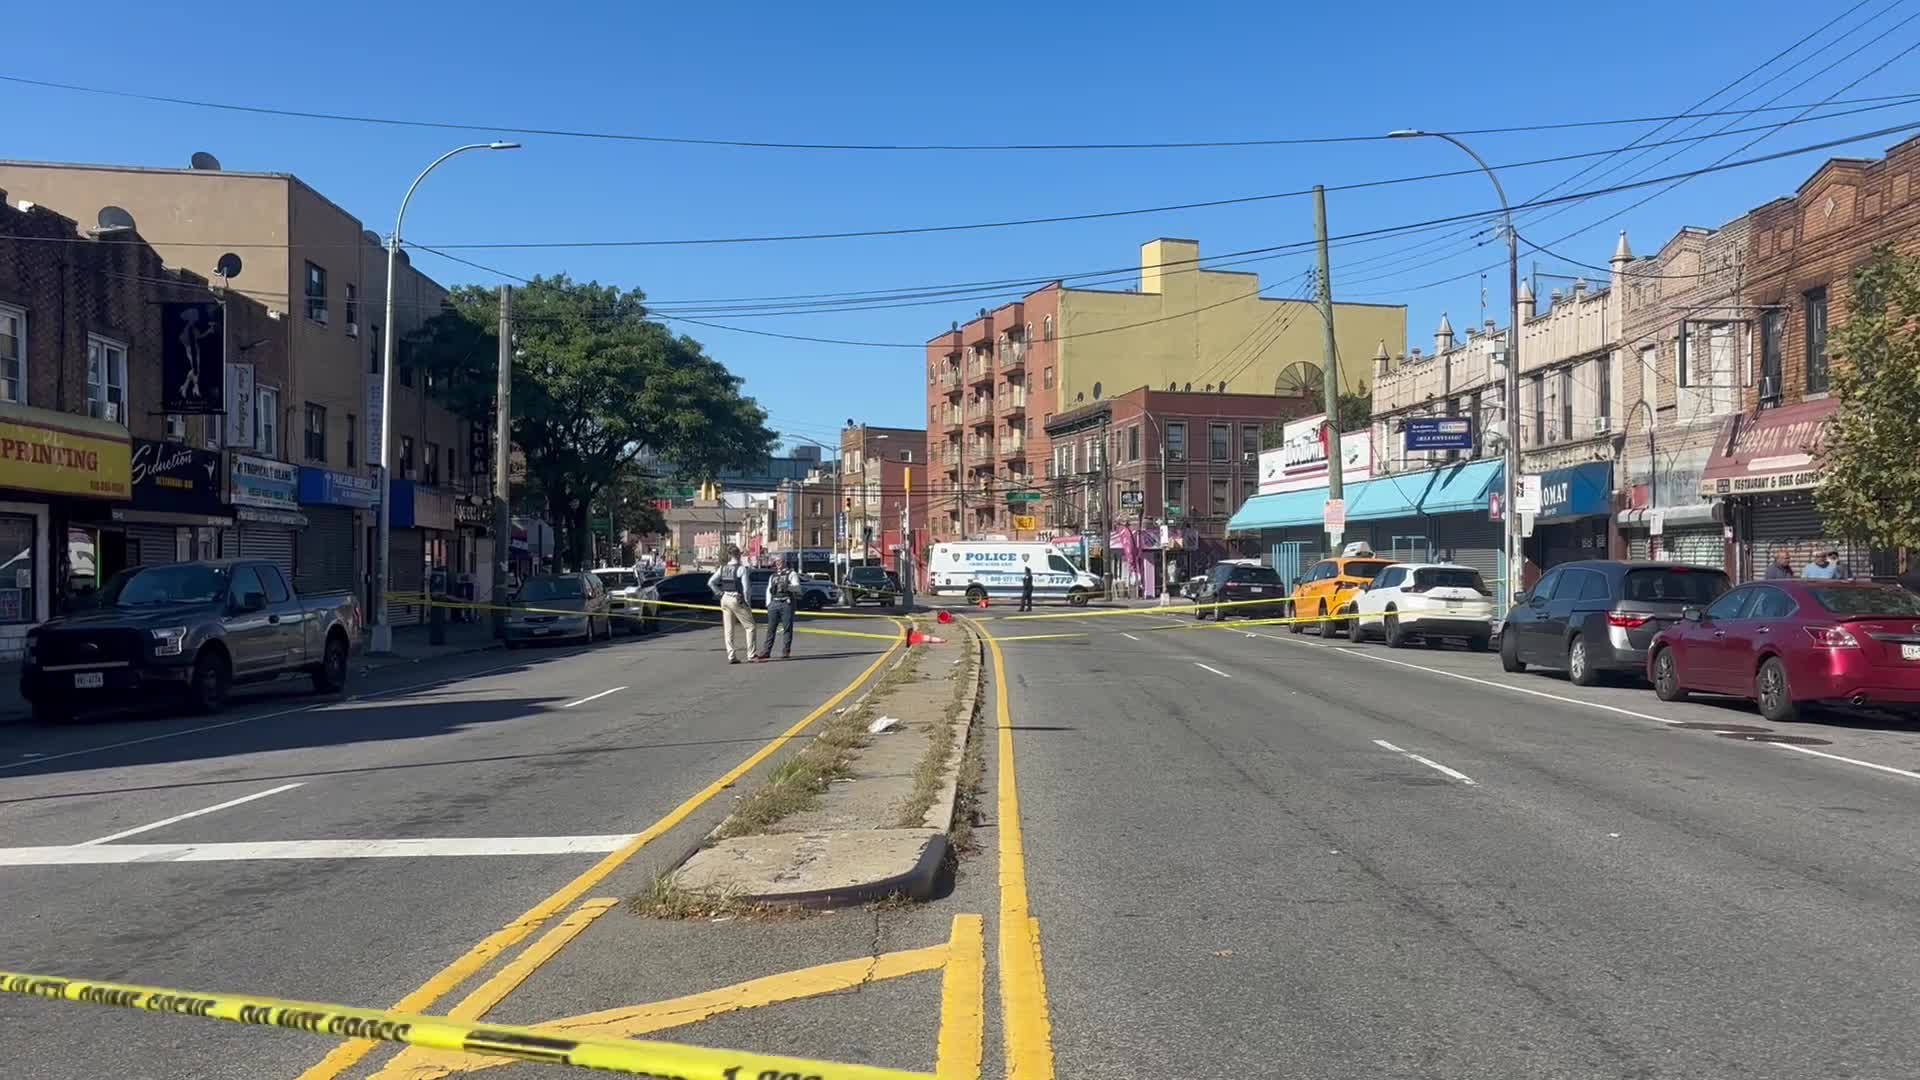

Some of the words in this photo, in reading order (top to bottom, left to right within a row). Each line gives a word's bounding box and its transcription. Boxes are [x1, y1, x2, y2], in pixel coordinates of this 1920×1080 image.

[1, 438, 98, 472] PRINTING
[965, 553, 1017, 561] POLICE
[1048, 576, 1073, 584] NYPD
